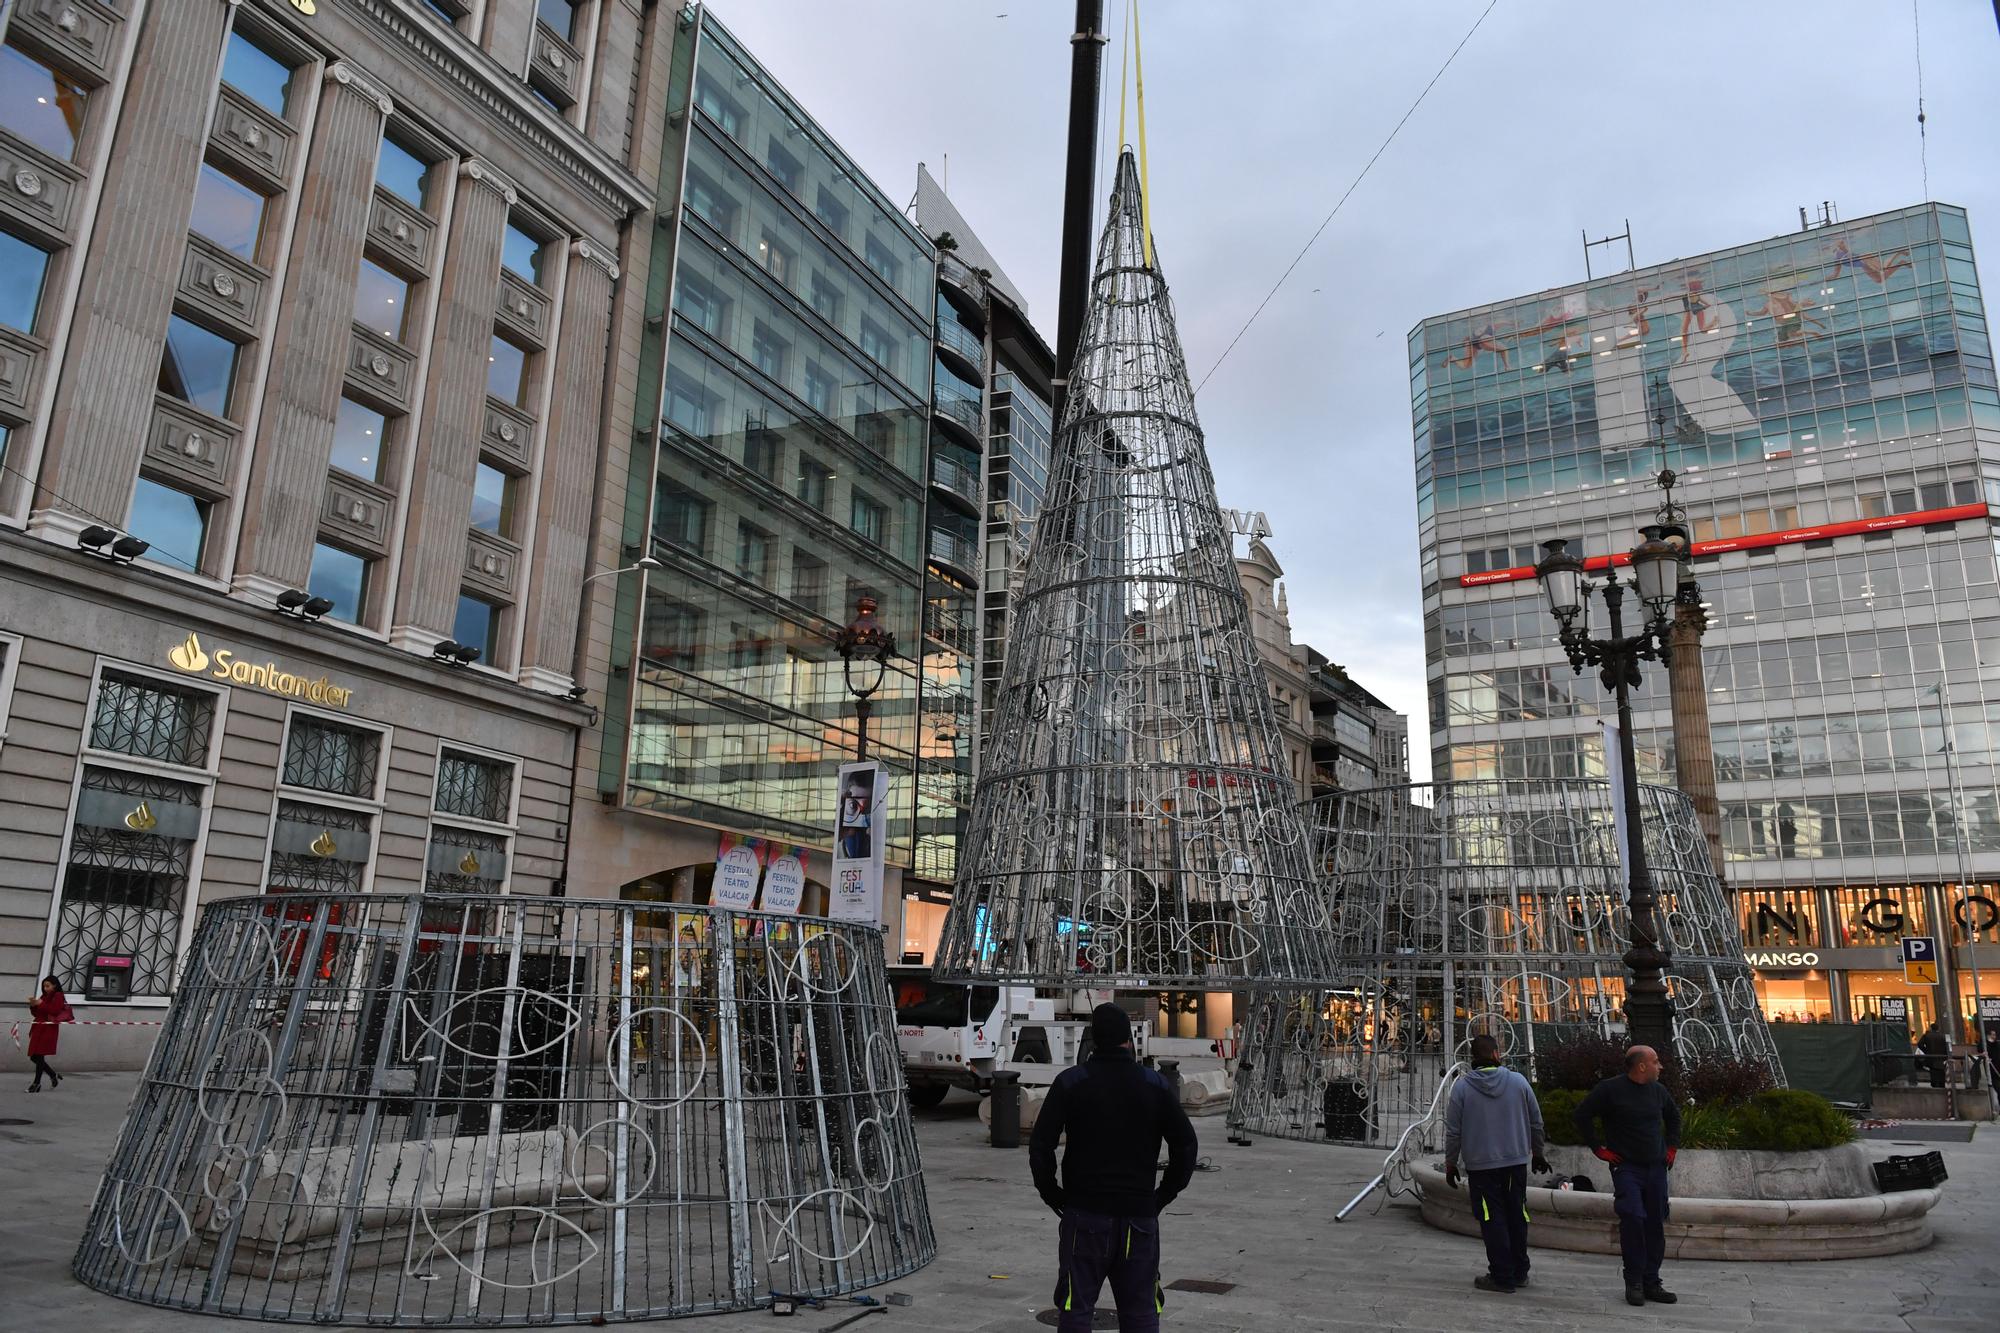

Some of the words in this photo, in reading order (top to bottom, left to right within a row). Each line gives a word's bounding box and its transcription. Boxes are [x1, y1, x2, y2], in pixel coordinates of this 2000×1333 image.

[1217, 508, 1273, 537] BVA
[212, 649, 353, 709] Santander
[729, 850, 753, 863] FTV
[723, 864, 753, 877] FESTIVAL
[777, 859, 799, 871] FTV
[772, 872, 799, 885] FESTIVAL
[840, 869, 863, 882] FEST
[724, 877, 750, 888] TEATRO
[719, 890, 750, 901] VALACAR
[772, 885, 796, 896] TEATRO
[767, 896, 796, 908] VALACAR
[1909, 940, 1927, 959] P
[1743, 952, 1819, 966] MANGO
[1882, 999, 1904, 1008] BLACK
[1882, 1008, 1906, 1017] FRIDAY
[904, 1029, 924, 1037] NORTE
